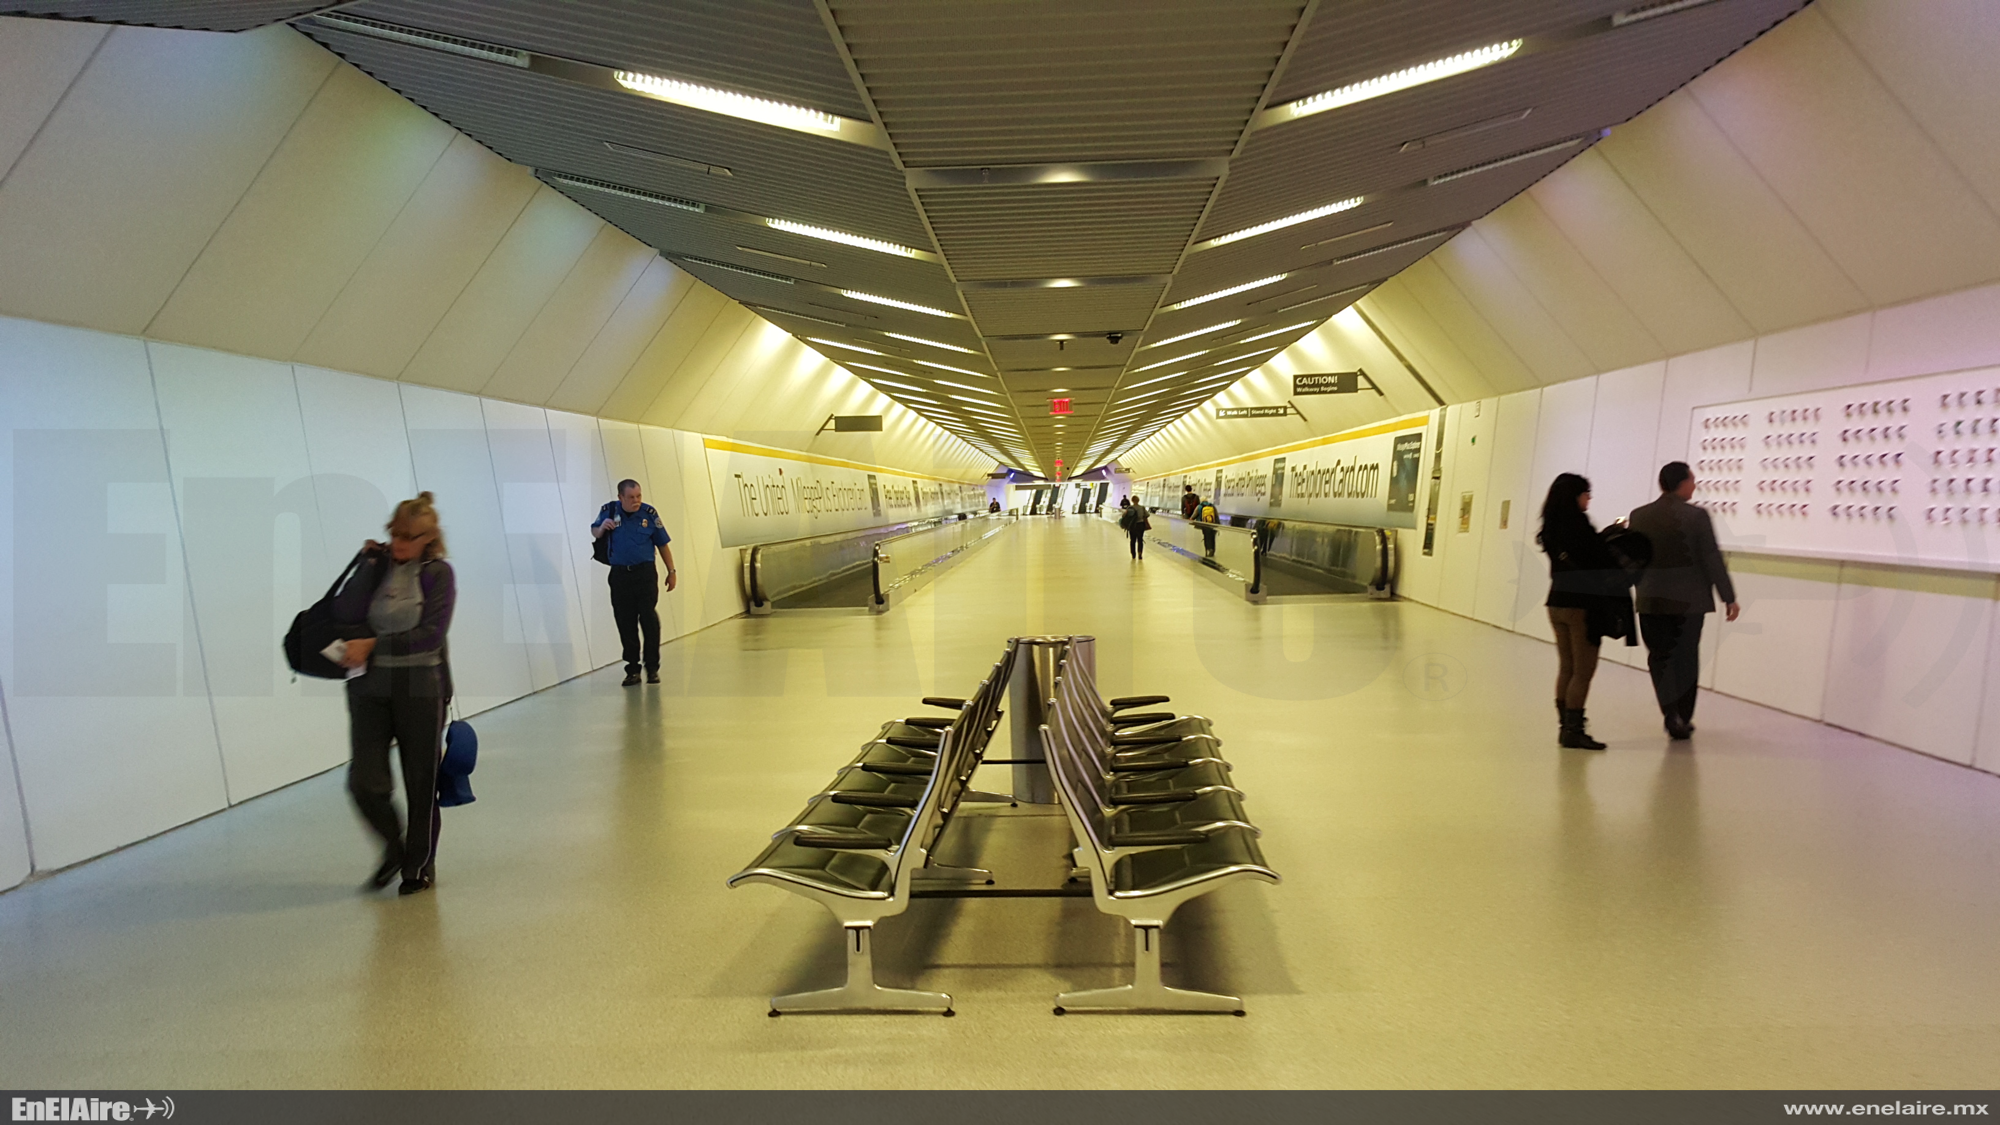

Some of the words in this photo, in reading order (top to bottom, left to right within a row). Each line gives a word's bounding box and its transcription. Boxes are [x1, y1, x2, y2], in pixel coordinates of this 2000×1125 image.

[1296, 375, 1338, 386] CAUTION!
[1320, 385, 1338, 393] Begins
[1264, 408, 1277, 416] Right
[1289, 455, 1379, 505] TheExplorerCard.com
[734, 472, 760, 517] The
[756, 474, 790, 516] United
